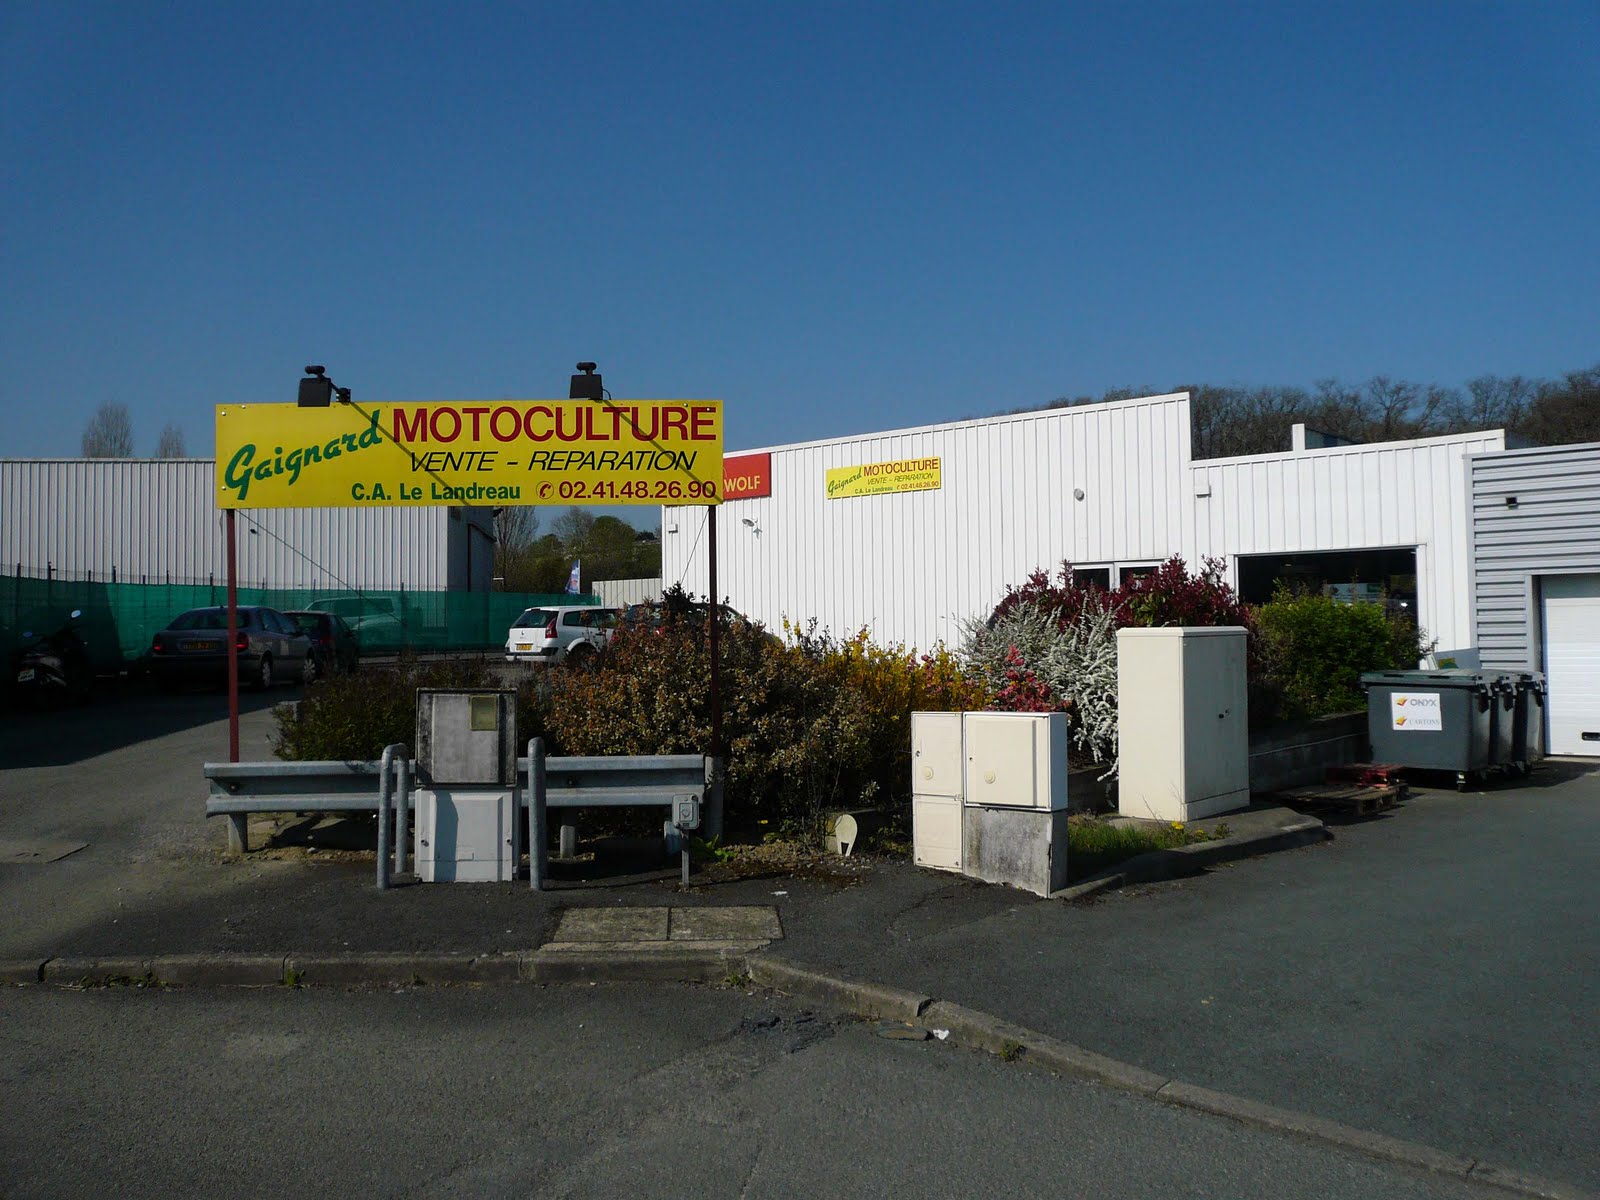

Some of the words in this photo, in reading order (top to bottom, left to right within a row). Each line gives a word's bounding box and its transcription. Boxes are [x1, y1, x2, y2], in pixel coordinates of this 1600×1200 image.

[393, 406, 717, 443] MOTOCULTURE
[224, 410, 383, 500] Gaignard
[410, 451, 498, 472] VENTE
[528, 450, 697, 471] REPARATION
[863, 458, 938, 476] MOTOCULTURE
[724, 475, 760, 492] WOLF
[828, 468, 862, 495] Gaignard
[867, 476, 888, 485] VENTE
[894, 472, 934, 482] REPARATION
[352, 483, 392, 501] C.A.
[400, 483, 423, 501] Le
[431, 482, 521, 501] Landreau
[559, 480, 716, 499] 02.41.48.26.90
